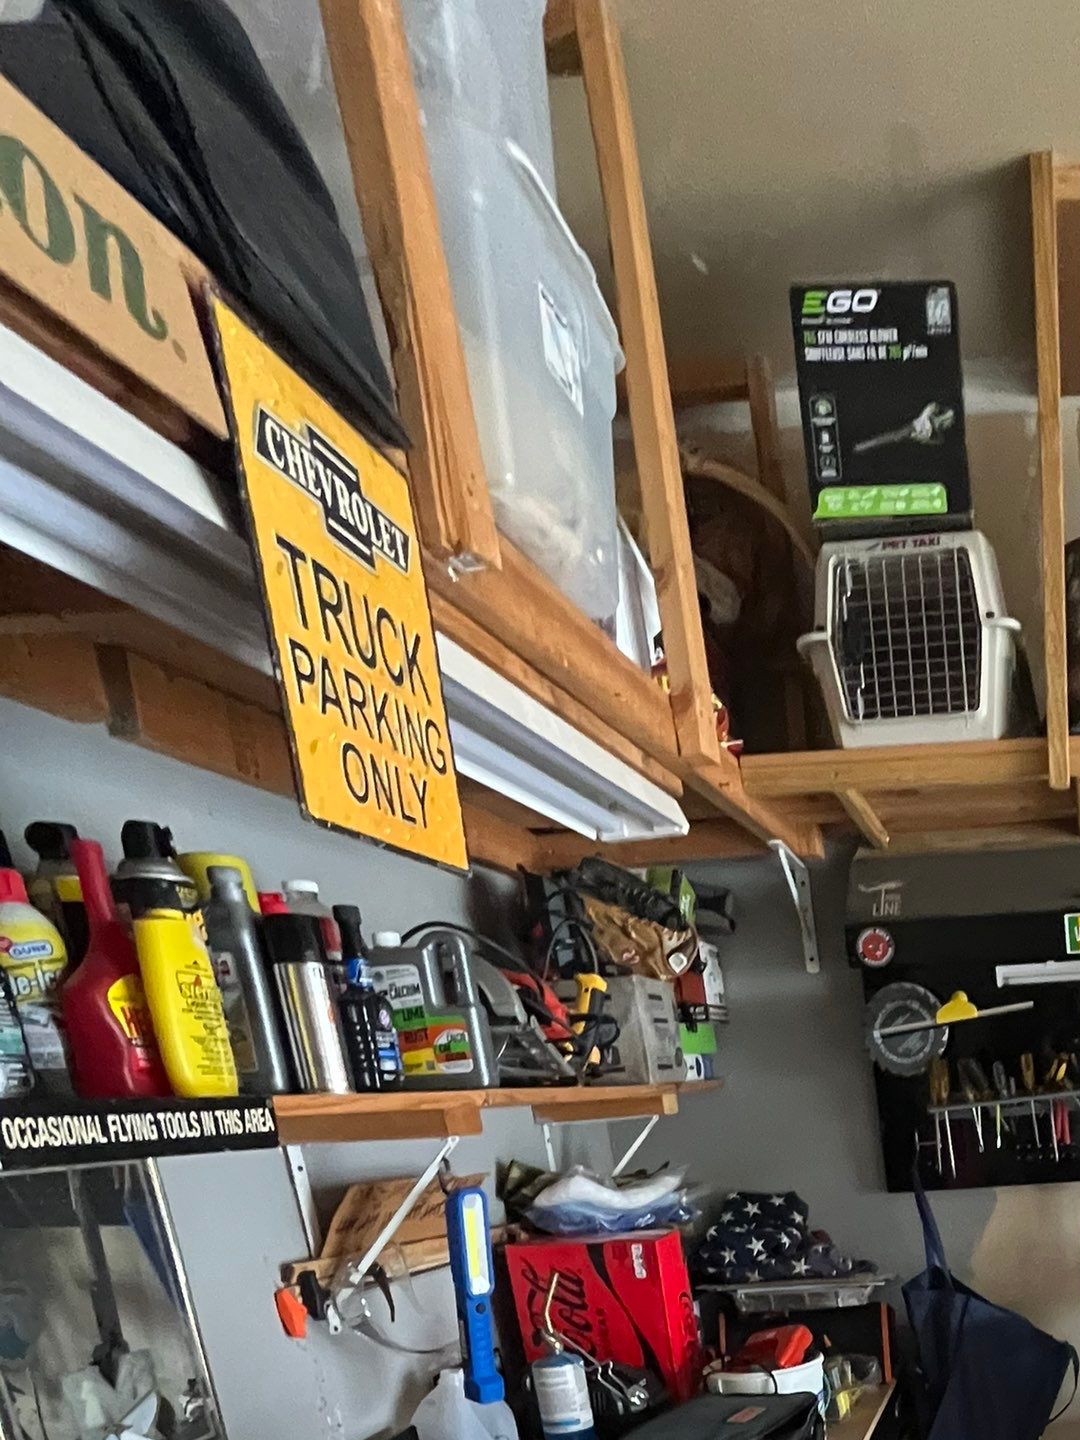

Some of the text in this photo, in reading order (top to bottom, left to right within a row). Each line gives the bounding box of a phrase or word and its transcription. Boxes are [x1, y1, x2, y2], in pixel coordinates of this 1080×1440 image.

[0, 134, 187, 363] on.
[801, 288, 879, 314] EGO
[264, 417, 408, 571] CHEVROLET
[274, 533, 432, 707] TRUCK
[288, 637, 448, 776] PARKING
[342, 741, 428, 830] ONLY
[1, 1106, 275, 1150] OCCASIONAL FLYING TOOLS IN THIS AREA
